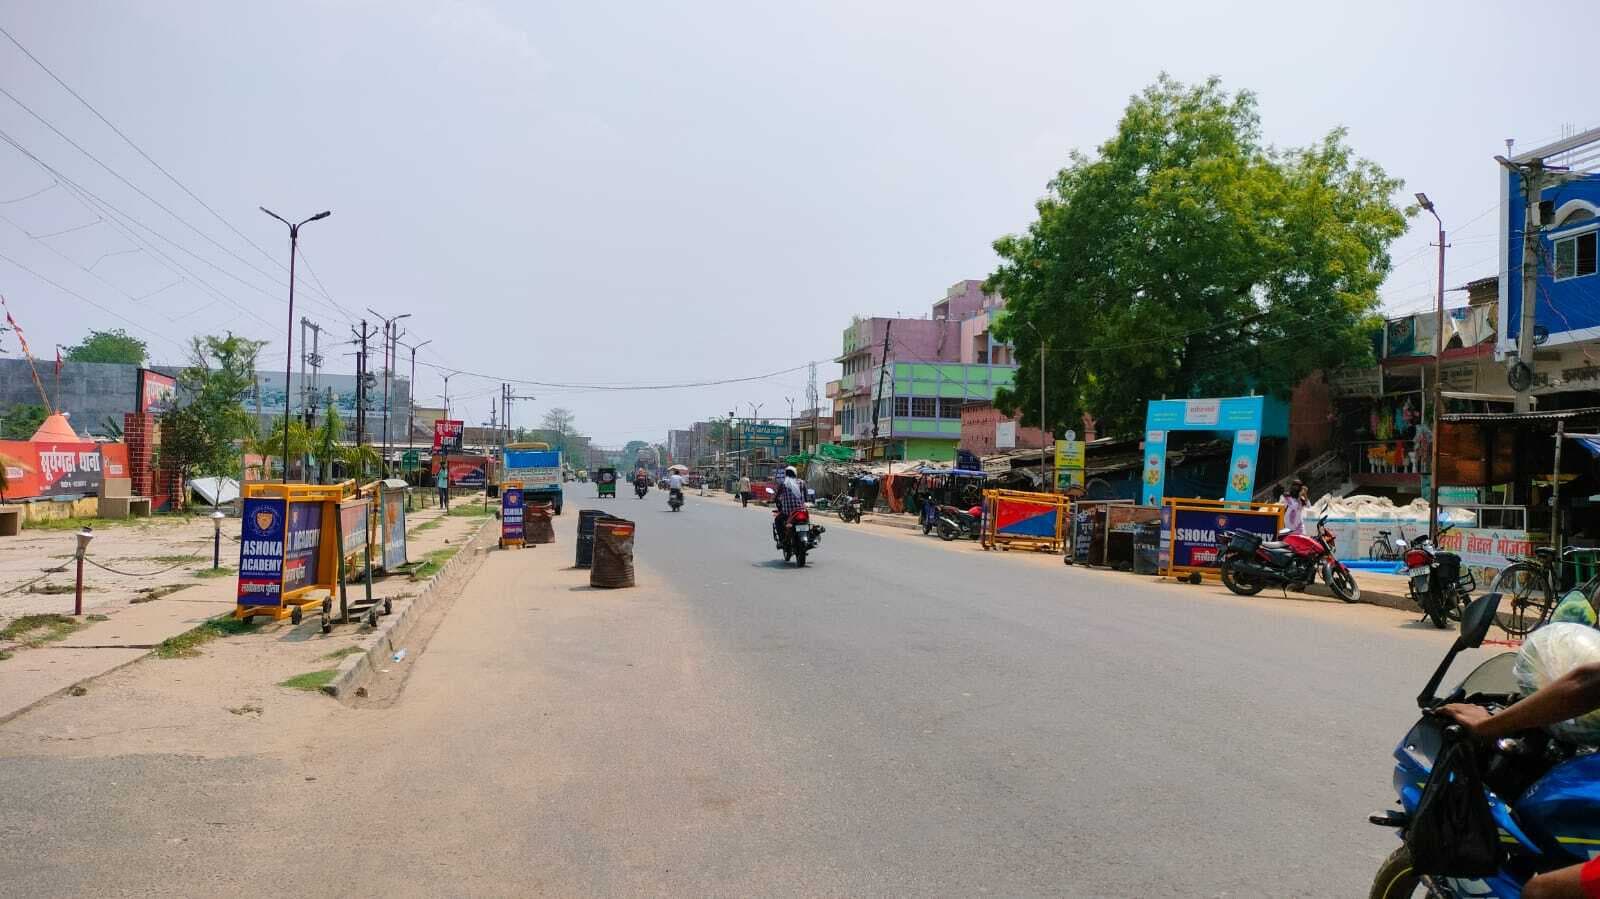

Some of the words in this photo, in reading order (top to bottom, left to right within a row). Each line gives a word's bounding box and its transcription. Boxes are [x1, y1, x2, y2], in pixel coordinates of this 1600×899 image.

[79, 451, 100, 472] थाना
[242, 540, 283, 556] ASHOKA
[242, 559, 282, 571] ACADEMY
